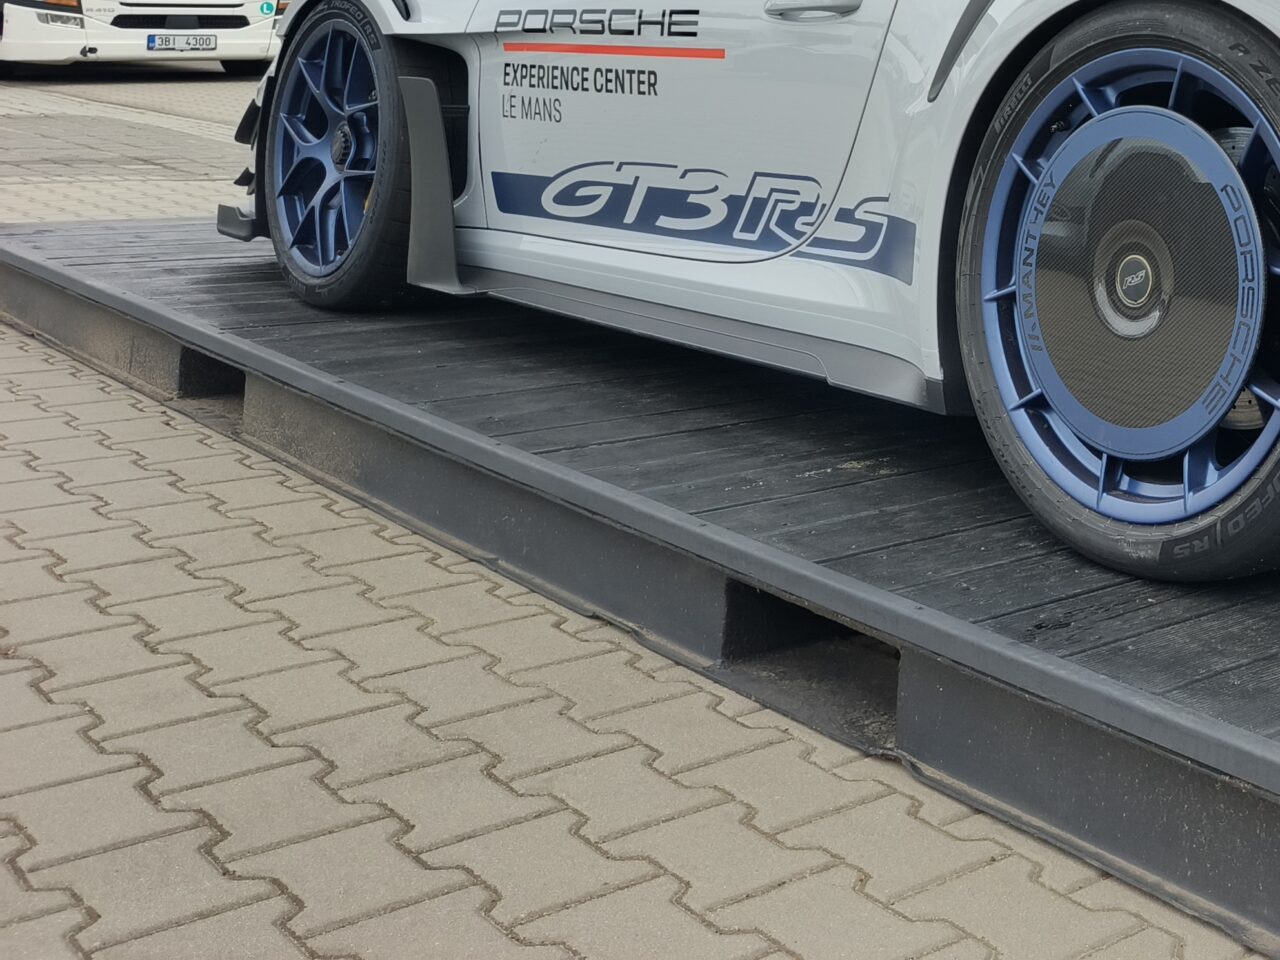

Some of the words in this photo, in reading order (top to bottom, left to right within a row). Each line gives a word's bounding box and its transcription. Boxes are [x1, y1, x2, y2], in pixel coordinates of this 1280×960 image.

[330, 0, 364, 20] TROFEO
[495, 9, 700, 37] PORSCHE
[185, 36, 212, 46] 4300
[504, 63, 589, 92] EXPERIENCE
[593, 66, 658, 96] CENTER
[502, 94, 517, 119] LE
[521, 96, 562, 123] MANS
[1022, 170, 1056, 320] MANTHEY
[1202, 184, 1255, 416] PORSCHE
[1173, 536, 1209, 559] RS
